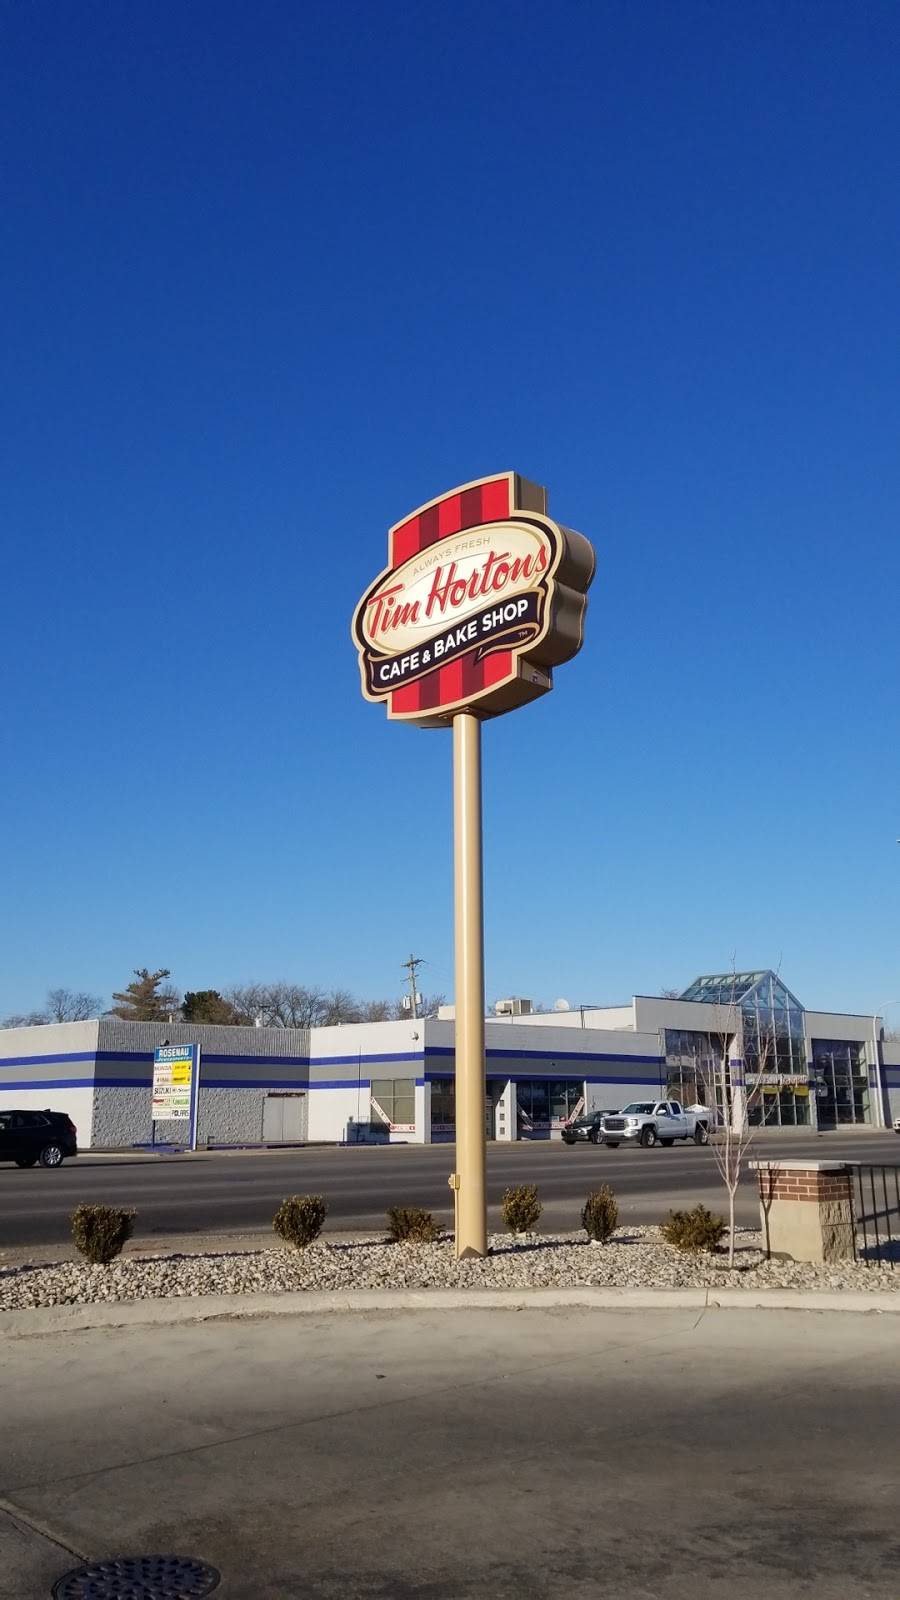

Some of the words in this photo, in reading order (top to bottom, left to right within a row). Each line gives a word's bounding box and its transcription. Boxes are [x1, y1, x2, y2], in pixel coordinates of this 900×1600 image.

[412, 548, 453, 577] ALWAYS
[454, 535, 492, 553] FRESH
[367, 583, 420, 639] Tim
[425, 544, 549, 617] Hortons
[379, 657, 420, 681] CAFE
[422, 650, 431, 664] &
[434, 625, 478, 660] BAKE
[482, 599, 529, 632] SHOP
[159, 1048, 189, 1057] ROSENAU
[154, 1087, 172, 1095] SUZUKI
